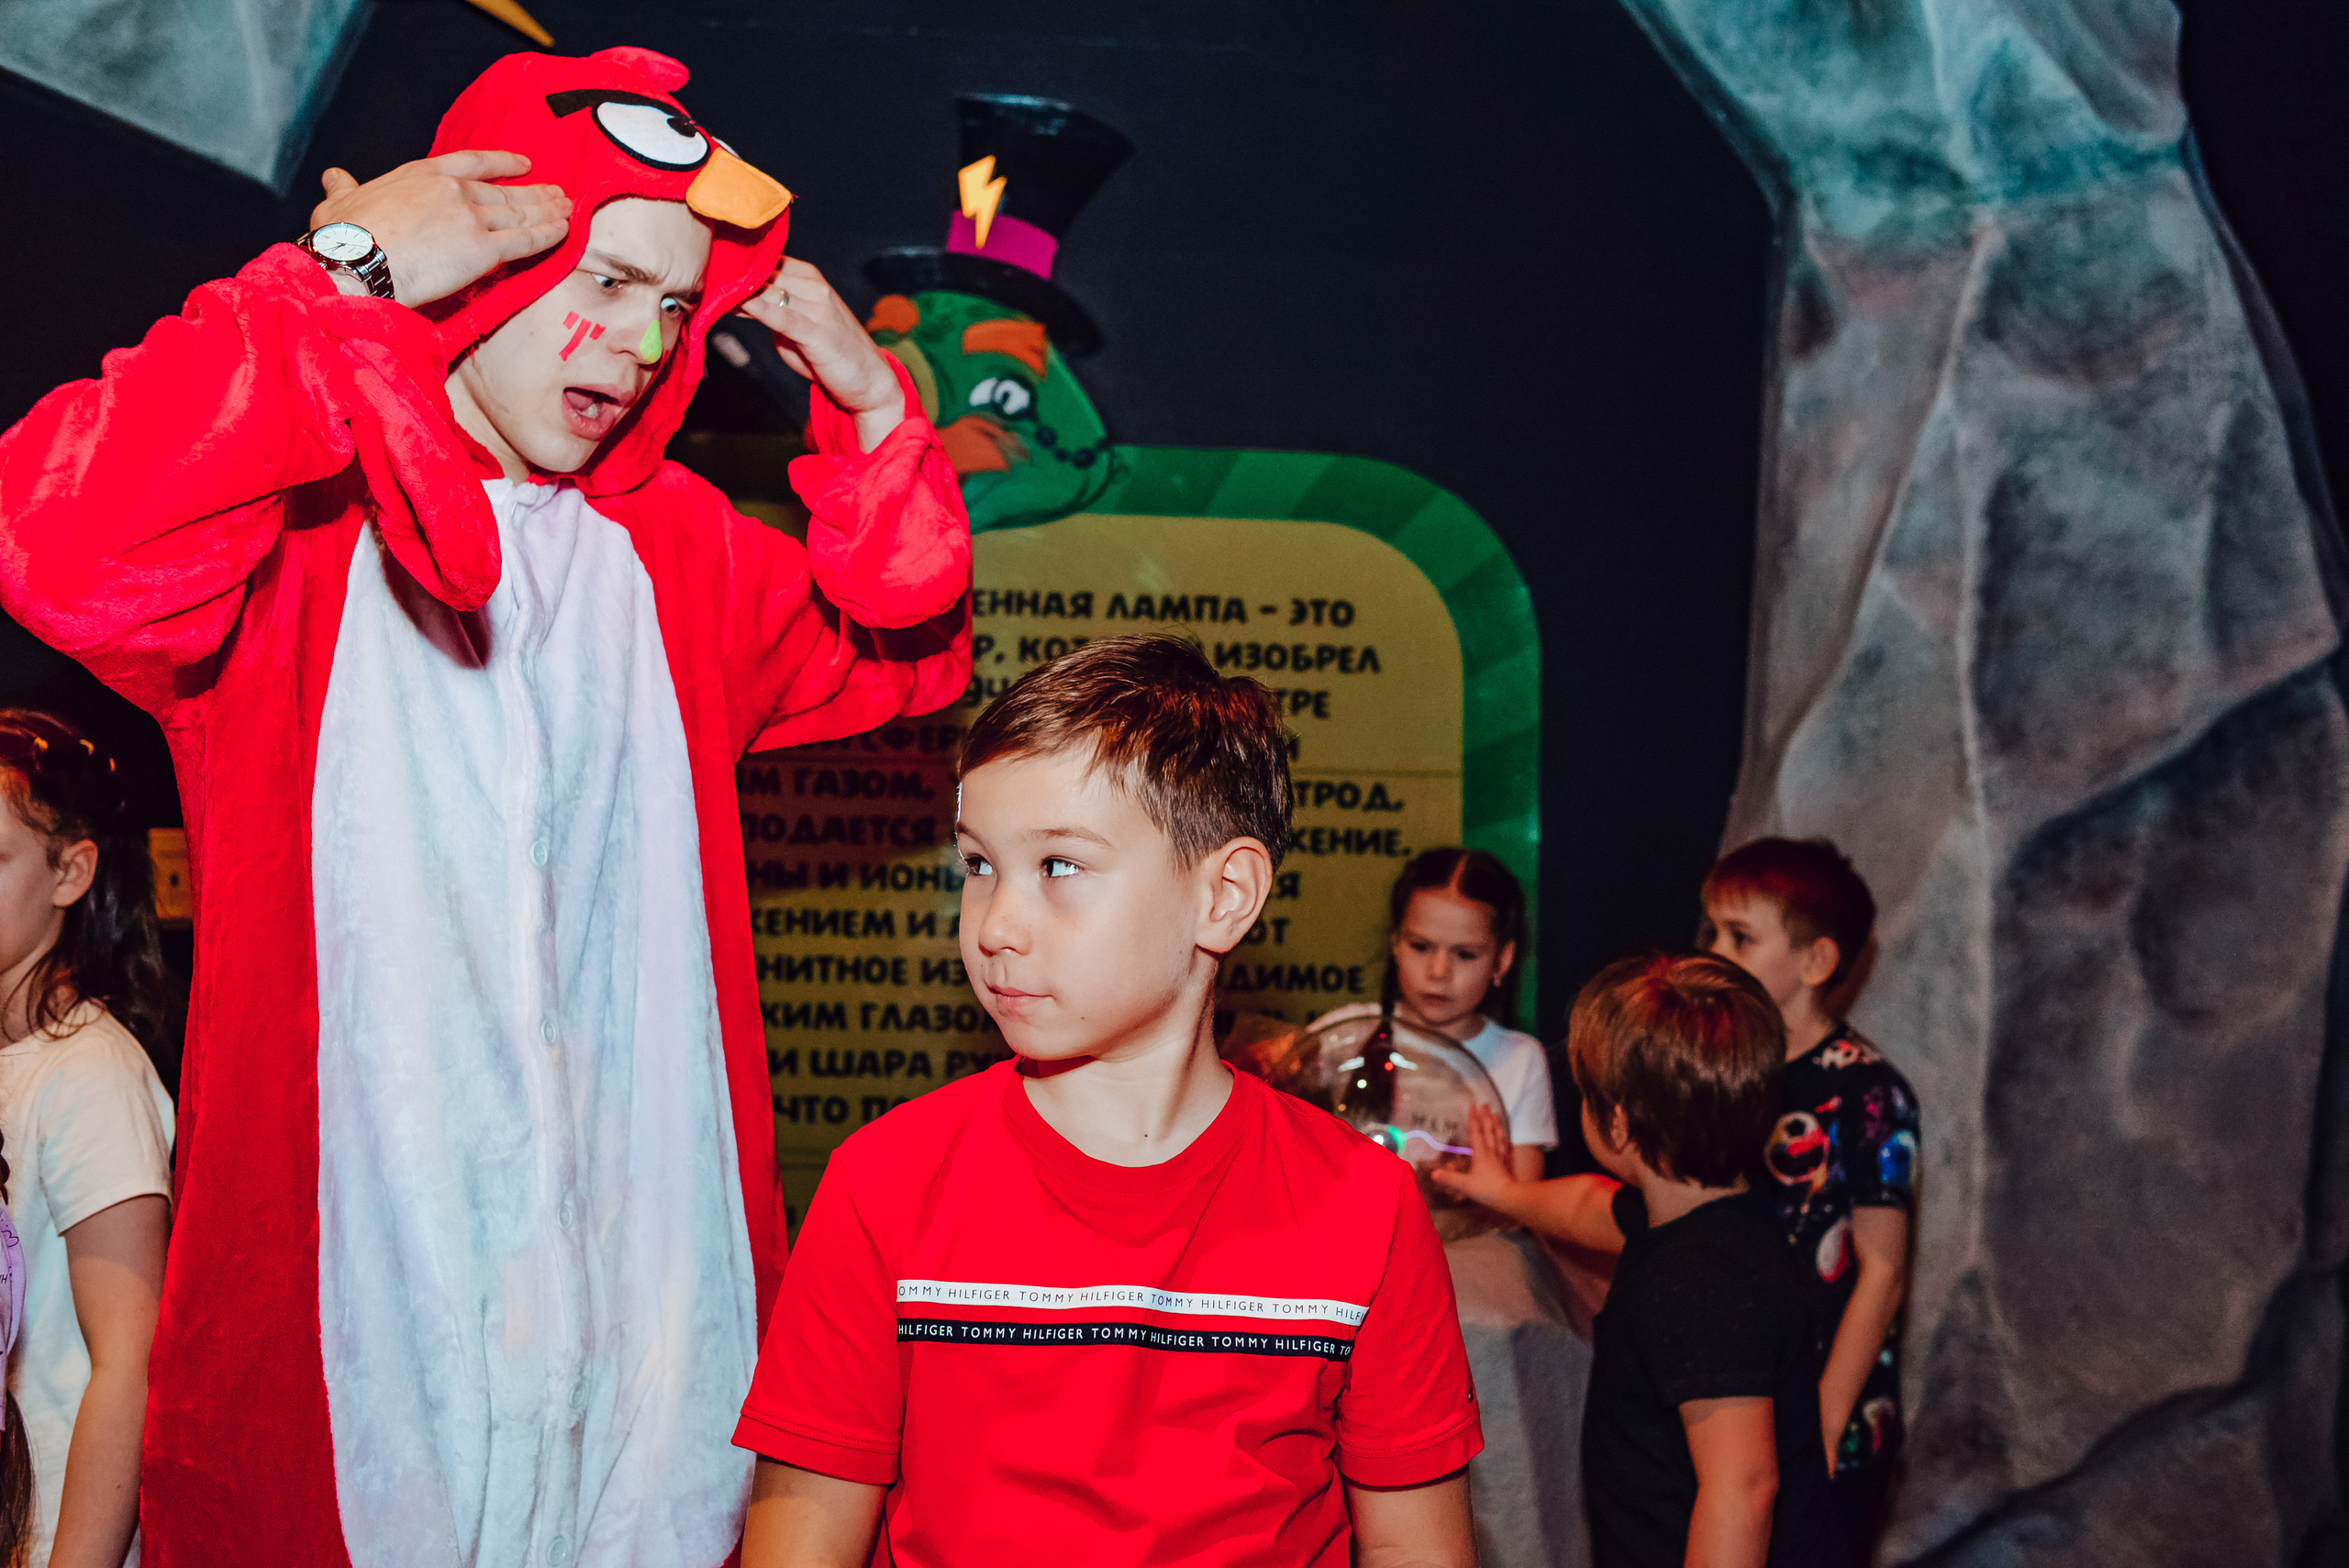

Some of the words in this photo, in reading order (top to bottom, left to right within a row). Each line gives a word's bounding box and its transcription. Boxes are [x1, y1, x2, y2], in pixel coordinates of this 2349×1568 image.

[1107, 593, 1246, 625] ЛАМПА
[1290, 598, 1355, 628] ЭТО
[1215, 642, 1380, 673] ИЗОБРЕЛ
[819, 863, 847, 889] И
[907, 910, 934, 939] И
[1218, 963, 1363, 994] ДИМОЕ
[810, 1051, 932, 1078] ШАРА
[775, 1095, 849, 1125] ЧТО
[898, 1285, 941, 1296] OMMY
[948, 1288, 1009, 1300] HILFIGER
[1019, 1291, 1074, 1303] TOMMY
[1080, 1291, 1144, 1302] HILFIGER
[1151, 1294, 1193, 1308] TOMMY
[1201, 1299, 1264, 1312] HILFIGER
[1273, 1303, 1329, 1314] TOMMY
[898, 1324, 953, 1337] HILFIGER
[962, 1326, 1016, 1339] TOMMY
[1022, 1329, 1084, 1340] HILFIGER
[1092, 1328, 1147, 1340] TOMMY
[1151, 1331, 1204, 1347] HILFIGER
[1212, 1336, 1268, 1349] TOMMY
[1275, 1339, 1335, 1354] HILFIGER
[1340, 1345, 1353, 1356] TO
